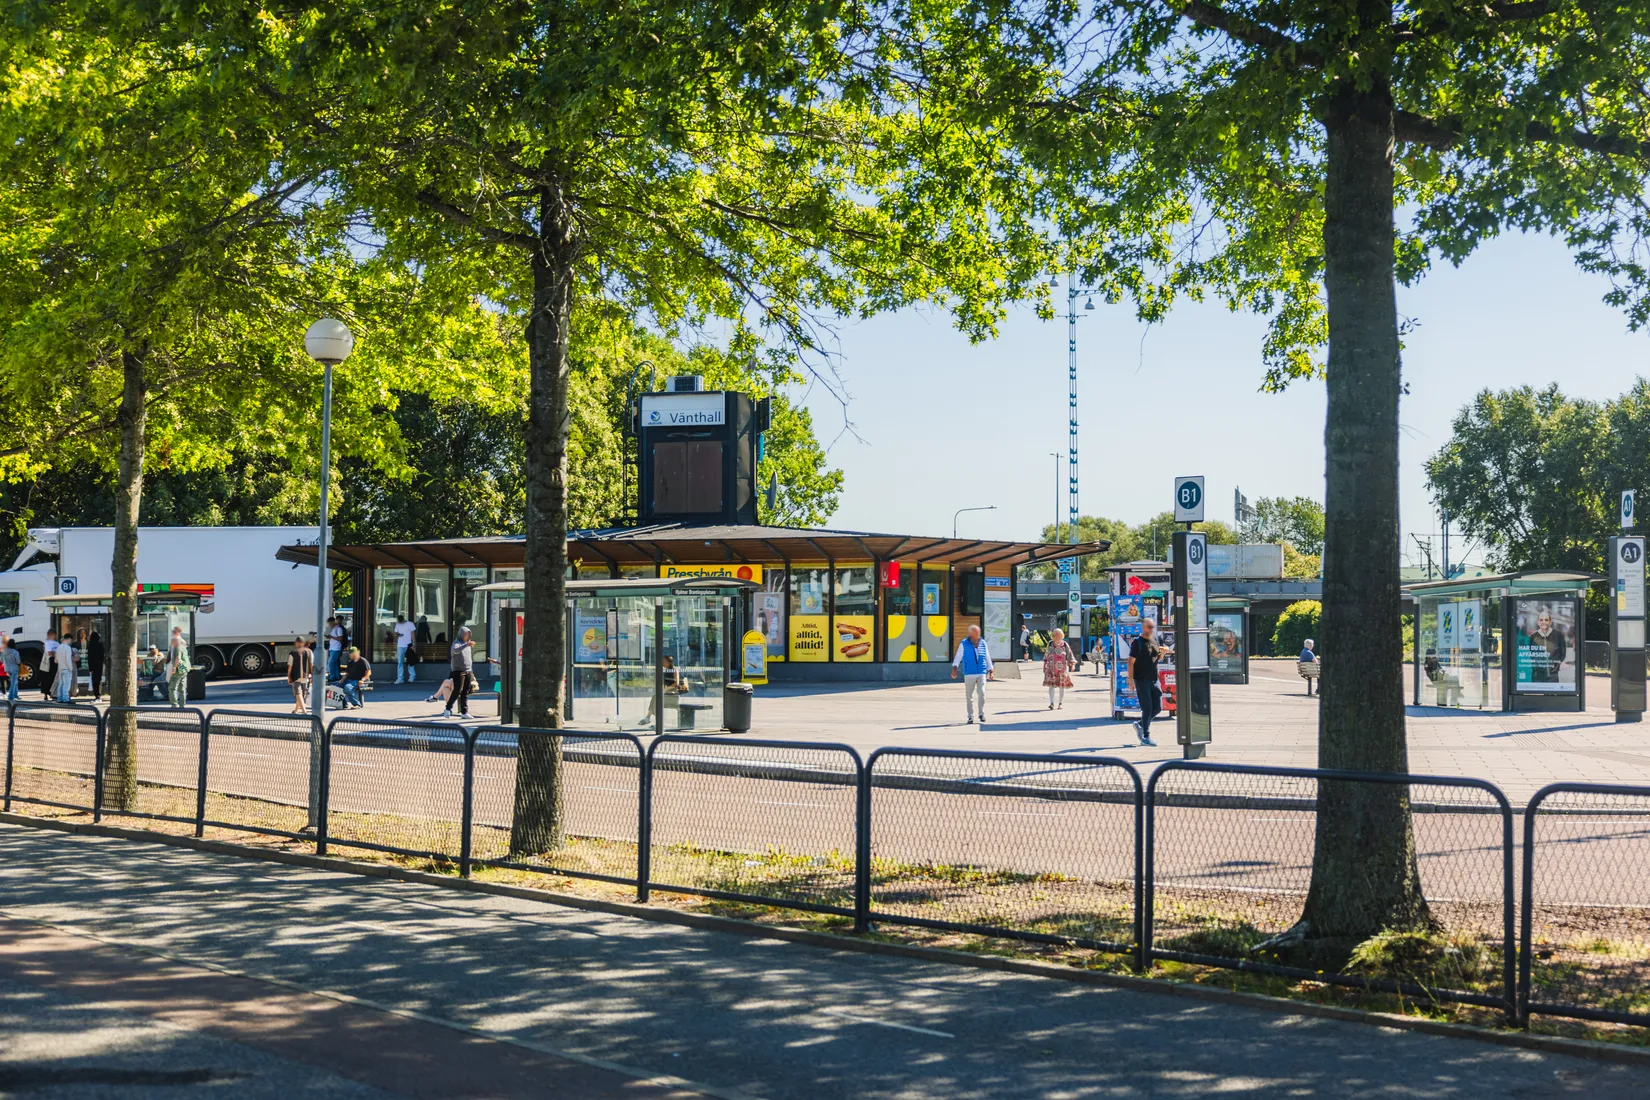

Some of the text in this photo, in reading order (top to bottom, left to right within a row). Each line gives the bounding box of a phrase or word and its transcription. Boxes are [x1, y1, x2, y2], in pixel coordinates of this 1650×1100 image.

[670, 411, 721, 423] Vänthall
[1182, 488, 1196, 503] B1
[1624, 500, 1631, 511] A1
[1191, 545, 1201, 559] B1
[1623, 547, 1638, 559] A1
[63, 583, 72, 591] B1
[796, 630, 822, 639] alltid,
[795, 640, 824, 650] alltid!
